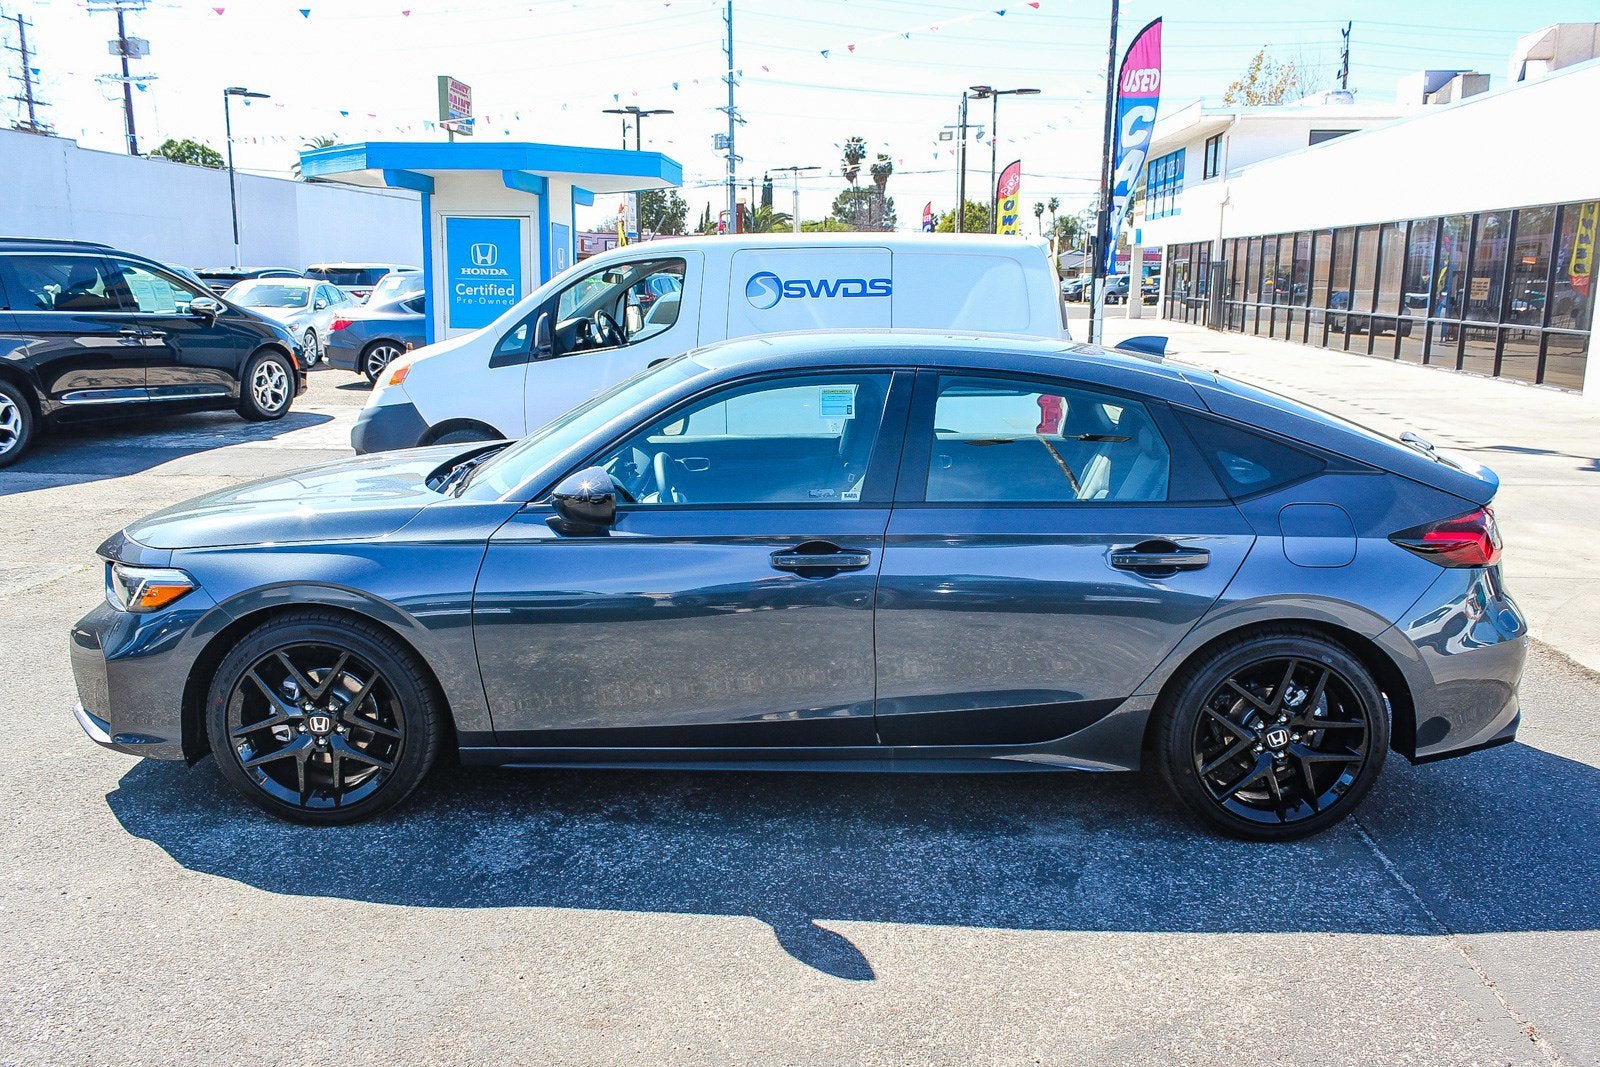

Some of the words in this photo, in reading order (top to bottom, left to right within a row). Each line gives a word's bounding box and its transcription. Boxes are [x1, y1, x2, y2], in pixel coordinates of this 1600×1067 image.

[1122, 67, 1160, 93] USED
[461, 267, 508, 276] HONDA
[455, 283, 515, 296] Certified
[783, 278, 892, 298] SWDS
[456, 296, 515, 305] Pre-Owned
